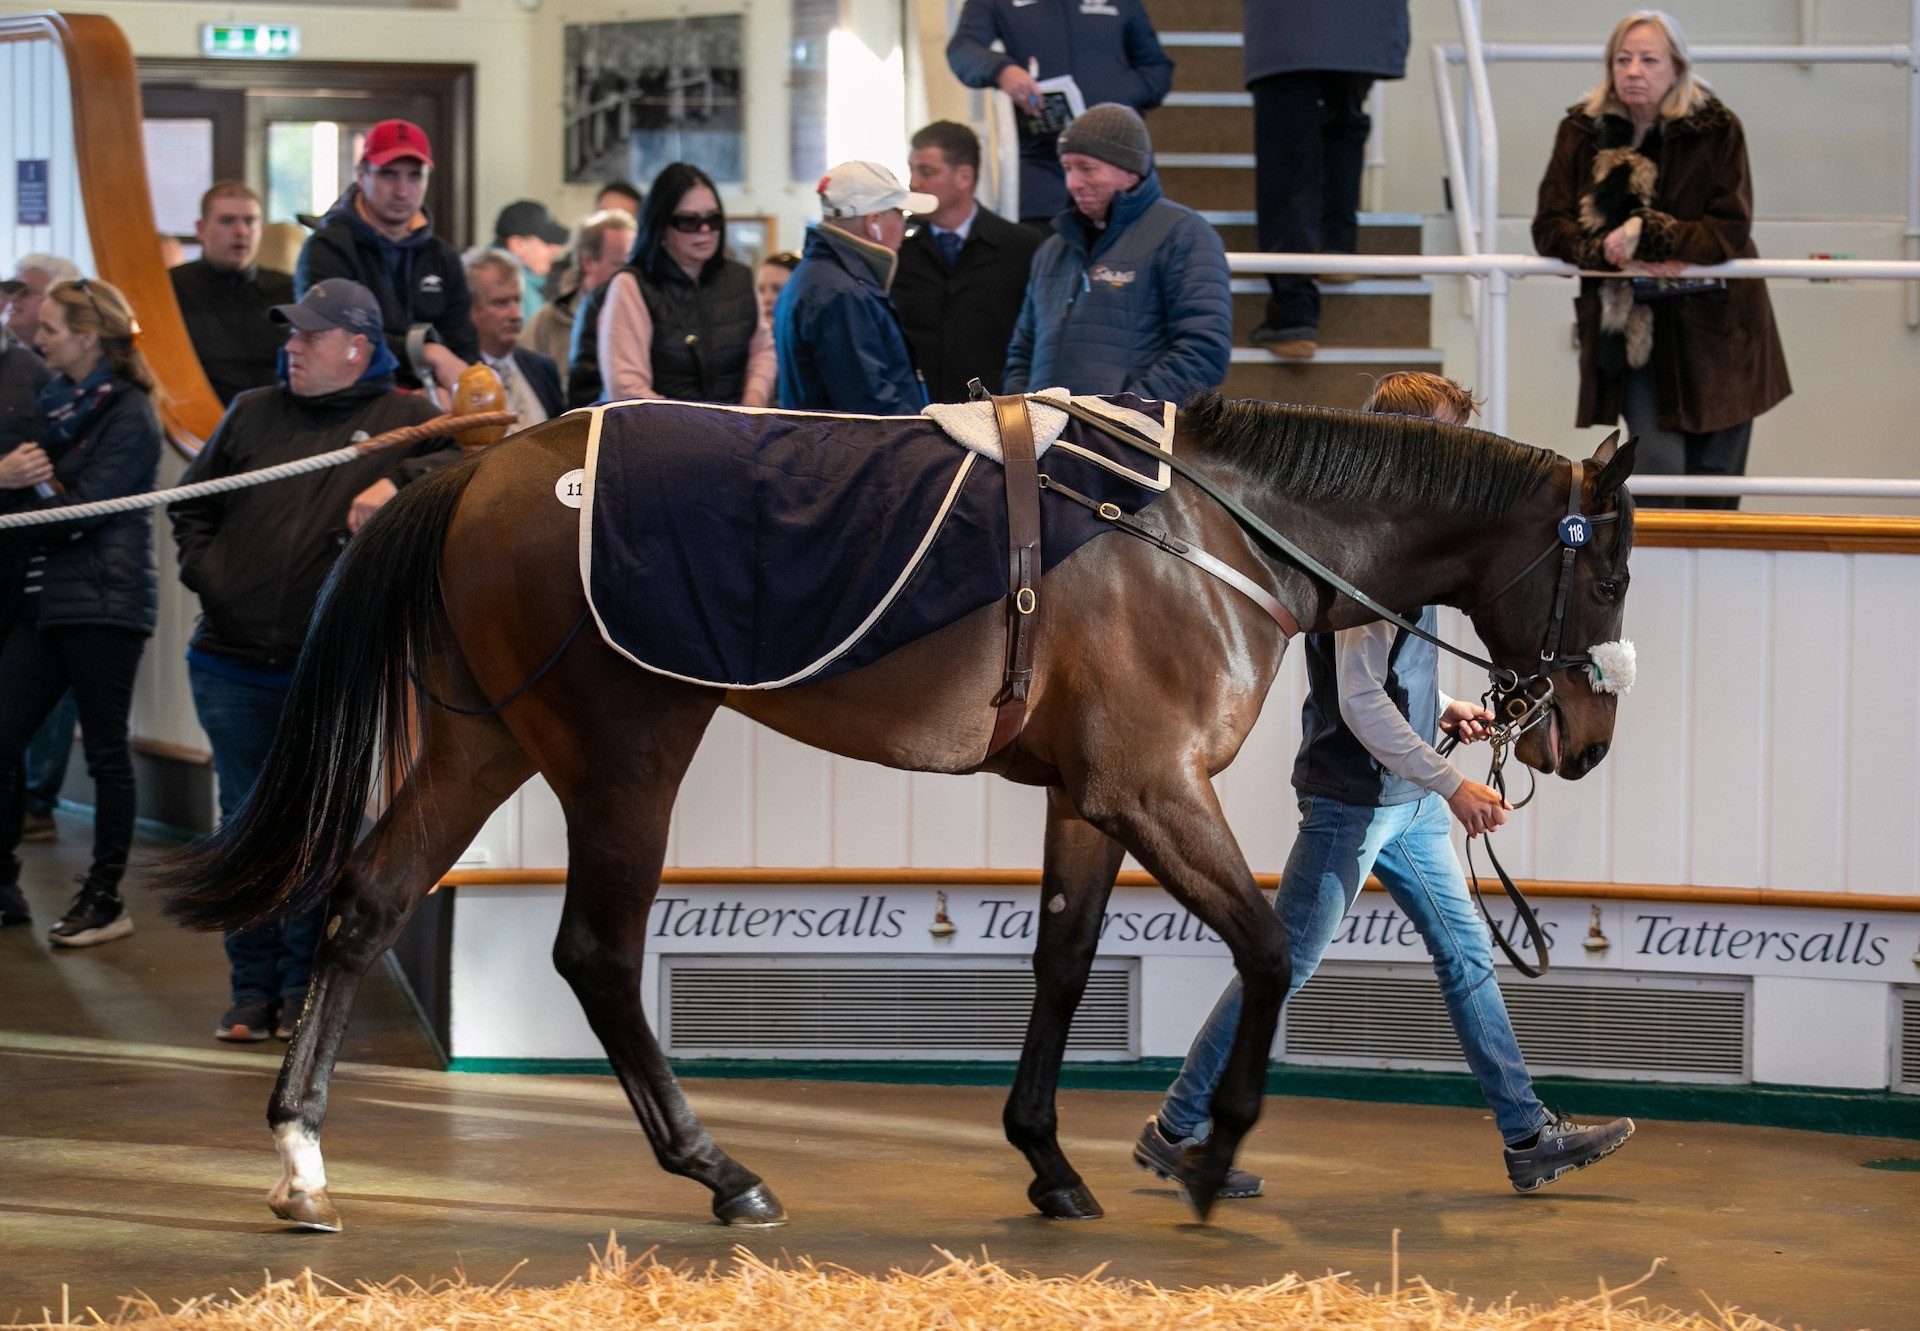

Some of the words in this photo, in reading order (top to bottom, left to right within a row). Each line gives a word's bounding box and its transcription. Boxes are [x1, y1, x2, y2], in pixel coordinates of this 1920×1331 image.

[566, 482, 583, 496] 11
[1567, 523, 1585, 542] 118
[652, 895, 906, 938] Tattersalls
[978, 899, 1223, 943] Tarsal
[1331, 907, 1560, 950] attells
[1635, 914, 1890, 966] Tattersalls
